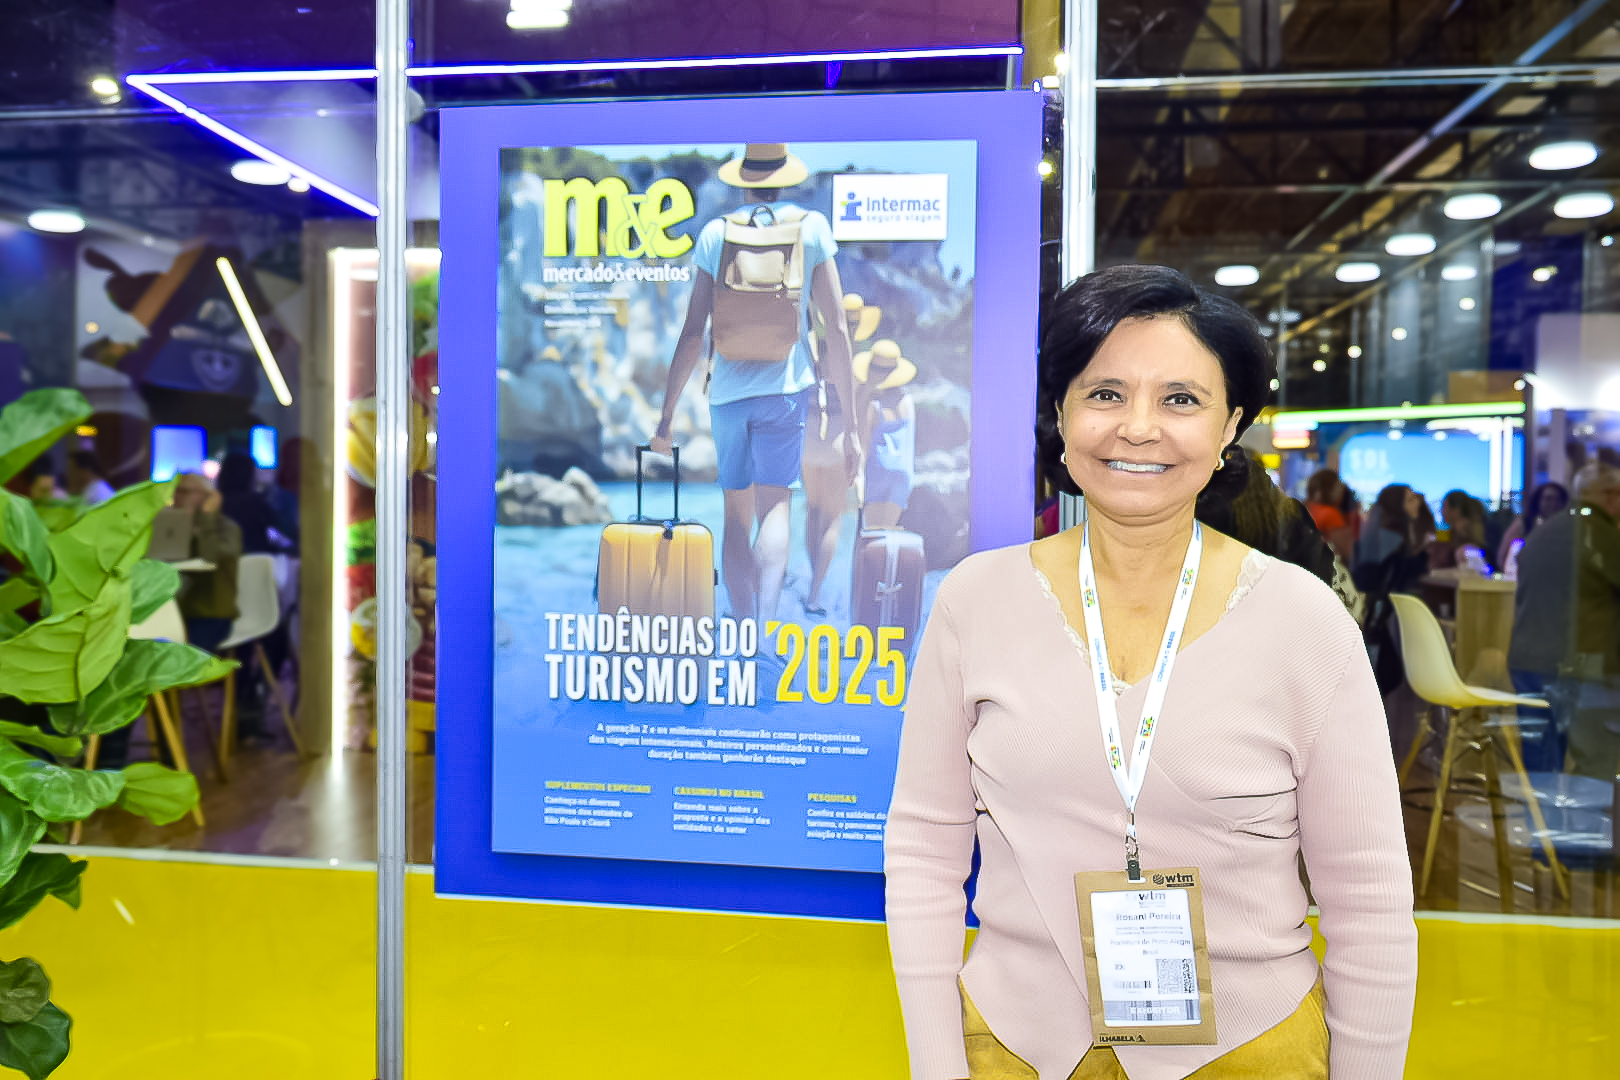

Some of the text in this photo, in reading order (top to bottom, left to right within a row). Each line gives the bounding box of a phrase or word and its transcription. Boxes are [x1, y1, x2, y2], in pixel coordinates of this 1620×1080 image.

[543, 177, 695, 259] m&e
[543, 262, 690, 283] mercado&eventos
[544, 606, 757, 658] TENDÊNCIAS DO
[545, 653, 756, 707] TURISMO EM
[799, 732, 861, 743] protagonistas
[745, 742, 812, 753] personalizados
[1165, 873, 1193, 883] wtm
[1138, 891, 1166, 900] wtm
